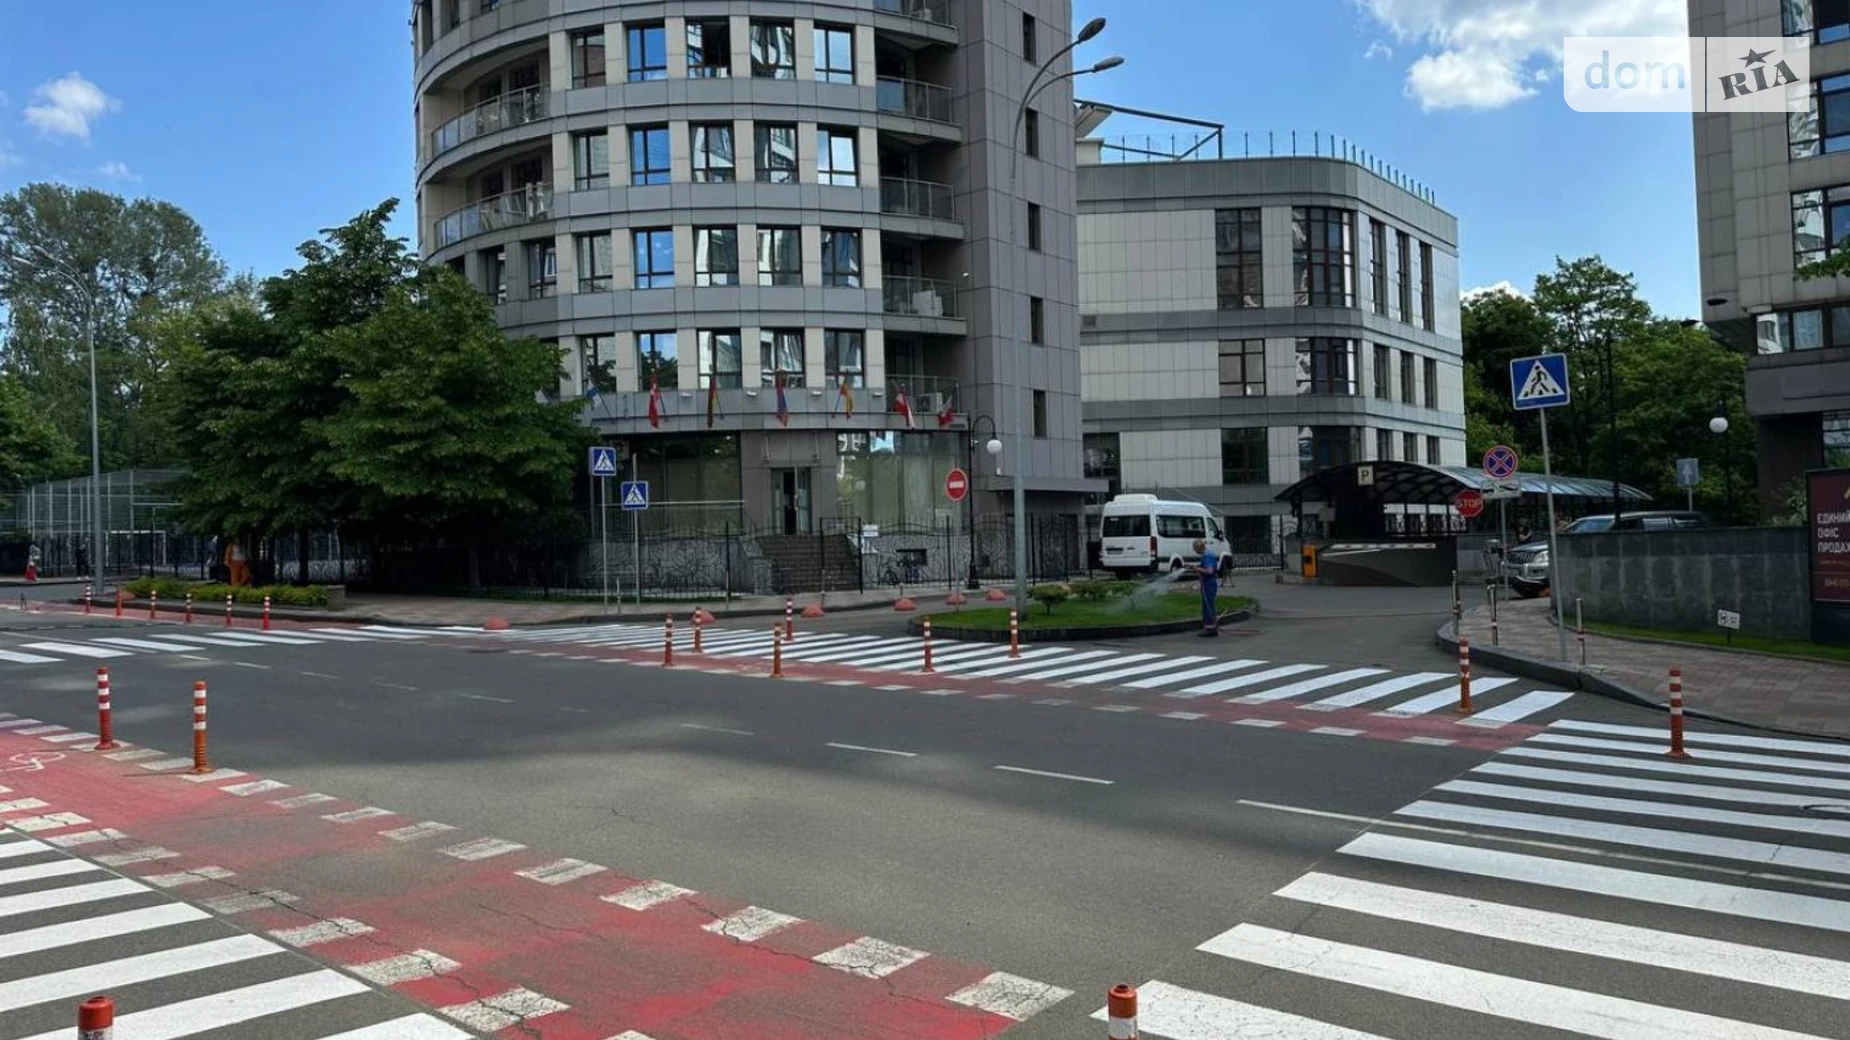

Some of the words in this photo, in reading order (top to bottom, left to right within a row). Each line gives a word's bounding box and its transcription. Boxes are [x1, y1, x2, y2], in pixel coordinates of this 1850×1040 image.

[1361, 469, 1370, 482] P
[1458, 498, 1481, 509] STOP
[1817, 526, 1840, 539] ОФІС
